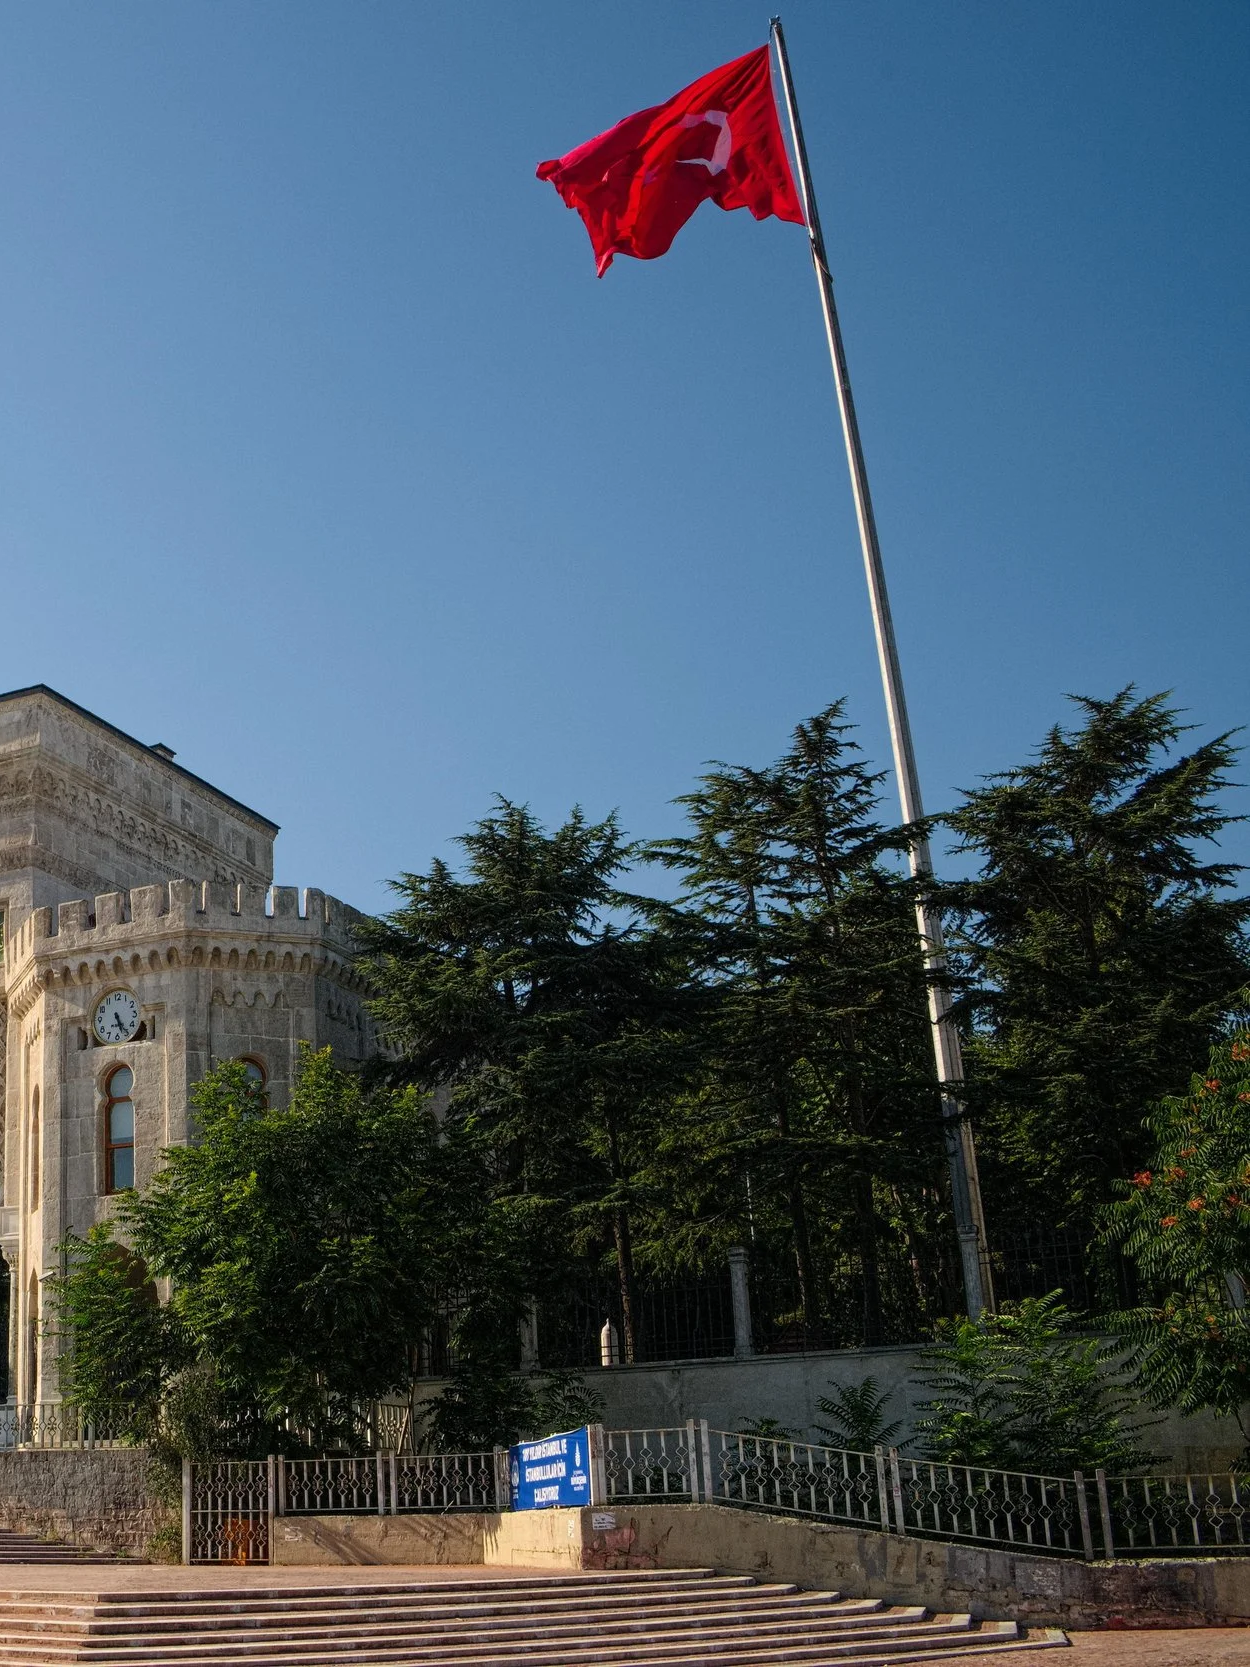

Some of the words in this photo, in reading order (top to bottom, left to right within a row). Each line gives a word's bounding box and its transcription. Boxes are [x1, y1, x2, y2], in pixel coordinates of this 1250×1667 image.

[106, 997, 111, 1005] 11
[114, 993, 121, 1001] 12
[130, 1000, 134, 1008] 2
[100, 1005, 106, 1014] 10
[132, 1010, 138, 1018] 3
[100, 1026, 106, 1034] 8
[106, 1032, 111, 1040] 7
[115, 1032, 120, 1040] 6
